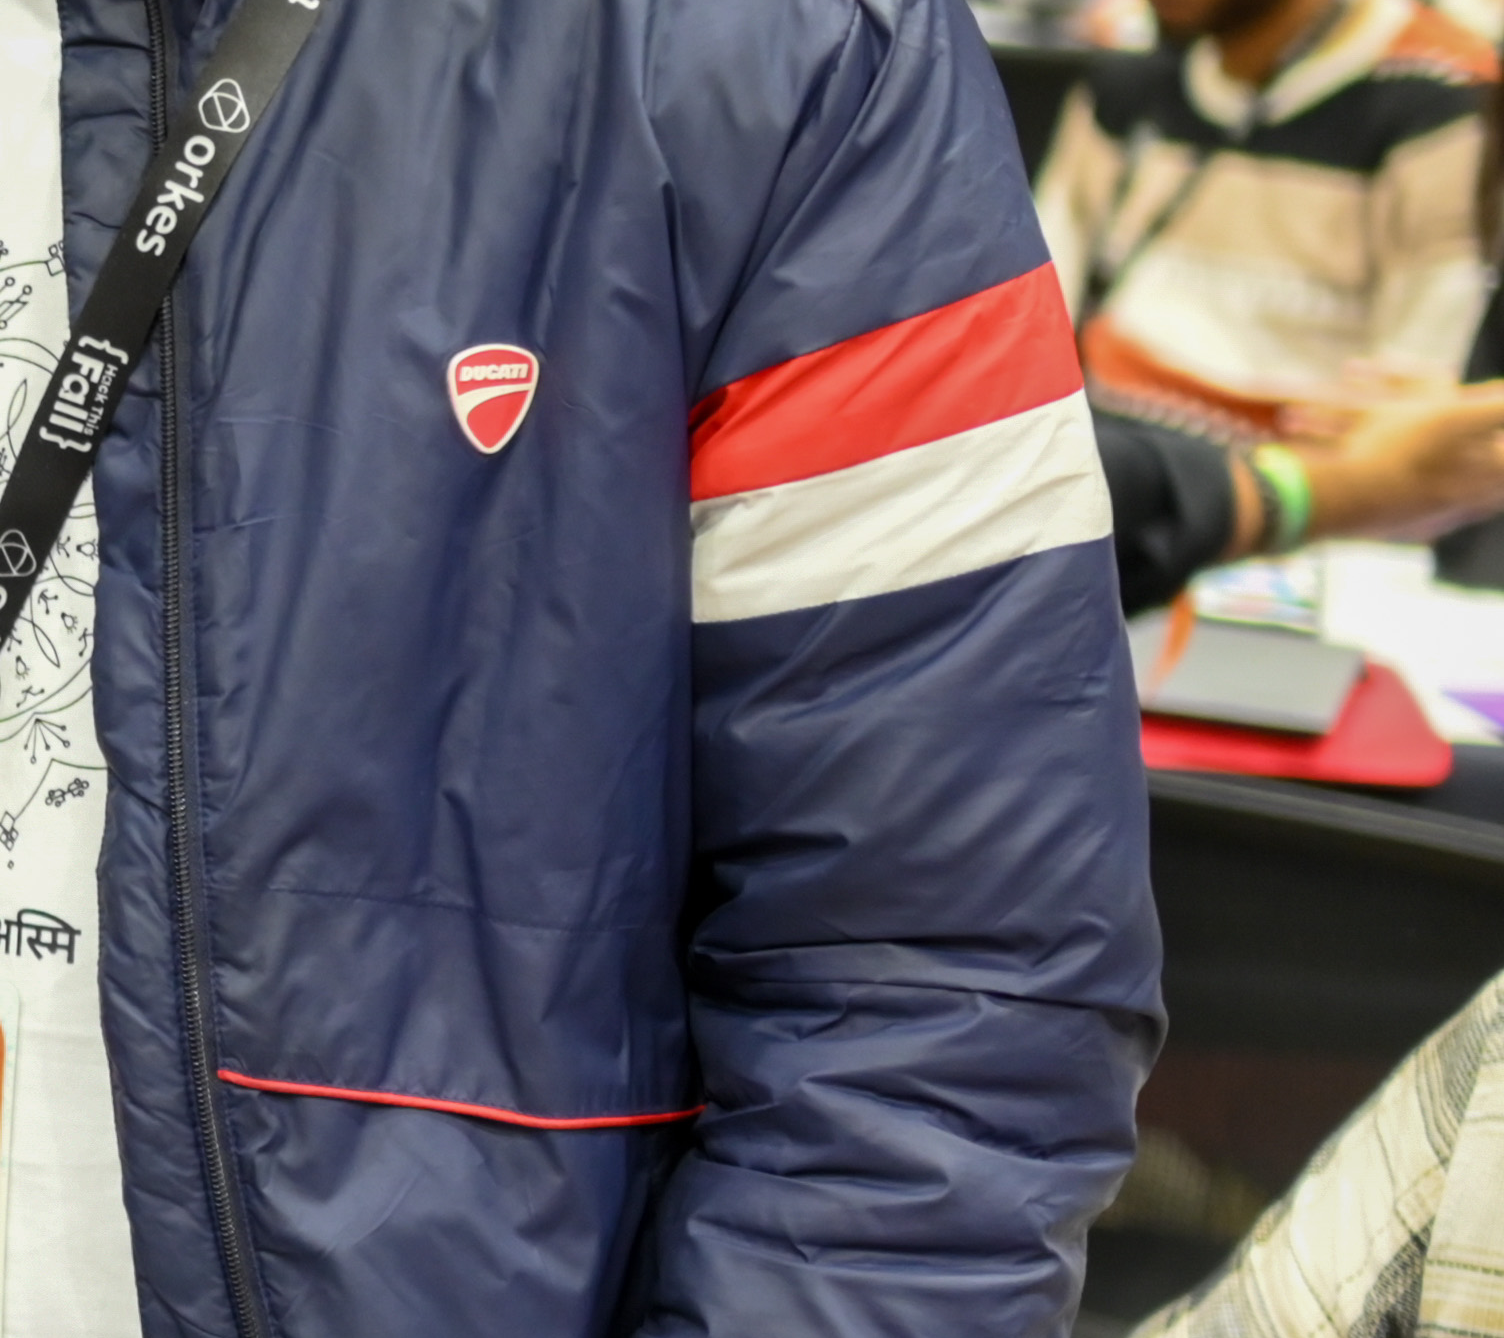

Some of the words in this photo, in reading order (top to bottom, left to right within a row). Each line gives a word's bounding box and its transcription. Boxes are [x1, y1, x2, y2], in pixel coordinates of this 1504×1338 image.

[136, 135, 216, 257] orkes
[94, 363, 119, 405] Hack
[459, 363, 529, 382] DUCATI
